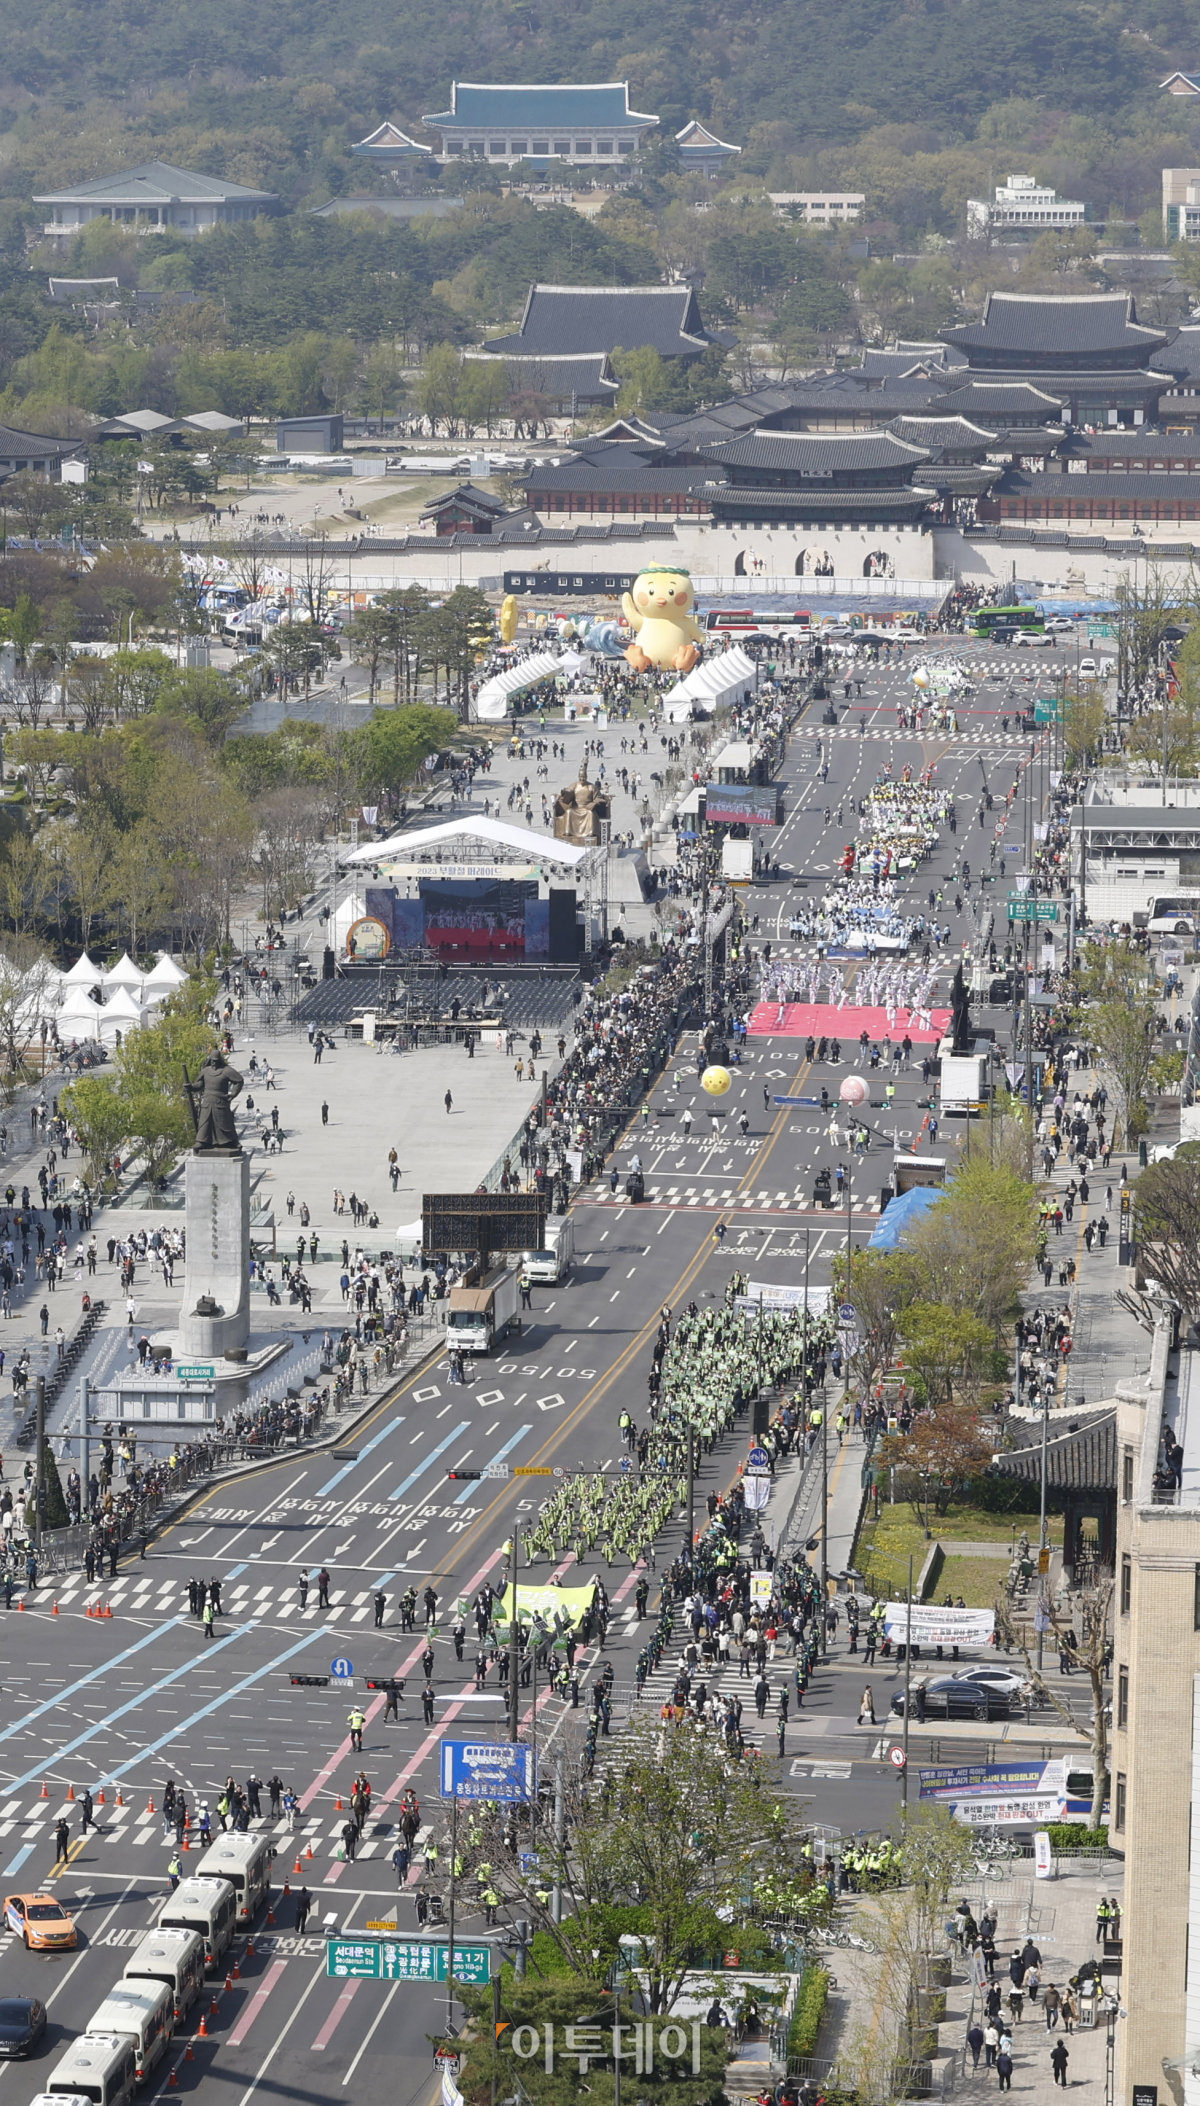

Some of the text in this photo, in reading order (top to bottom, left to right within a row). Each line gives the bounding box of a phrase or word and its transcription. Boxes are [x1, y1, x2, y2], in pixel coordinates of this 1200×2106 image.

[417, 866, 503, 876] 2023 부활절 퍼레이드
[789, 1125, 820, 1134] 50
[883, 1129, 913, 1138] 50
[1122, 1200, 1128, 1208] 3
[498, 1364, 540, 1375] 50
[556, 1367, 597, 1380] 50
[277, 1497, 345, 1513] 시의회
[348, 1501, 414, 1517] 시의회
[417, 1505, 483, 1521] 시의회
[956, 1768, 968, 1776] 서민
[969, 1768, 986, 1776] 죽이는
[964, 1801, 1051, 1814] 윤석열 한미일 동맹 완성 환영
[970, 1812, 996, 1821] 검수완박
[998, 1811, 1011, 1820] 헌재
[97, 1928, 148, 1948] 서대
[256, 1935, 328, 1957] 광화문
[397, 1946, 432, 1957] 독립문
[335, 1946, 375, 1958] 서대문역
[335, 1956, 364, 1965] Seodaemun
[397, 1957, 432, 1968] 광화문
[399, 1967, 428, 1975] 光化門
[459, 1972, 465, 1980] 6
